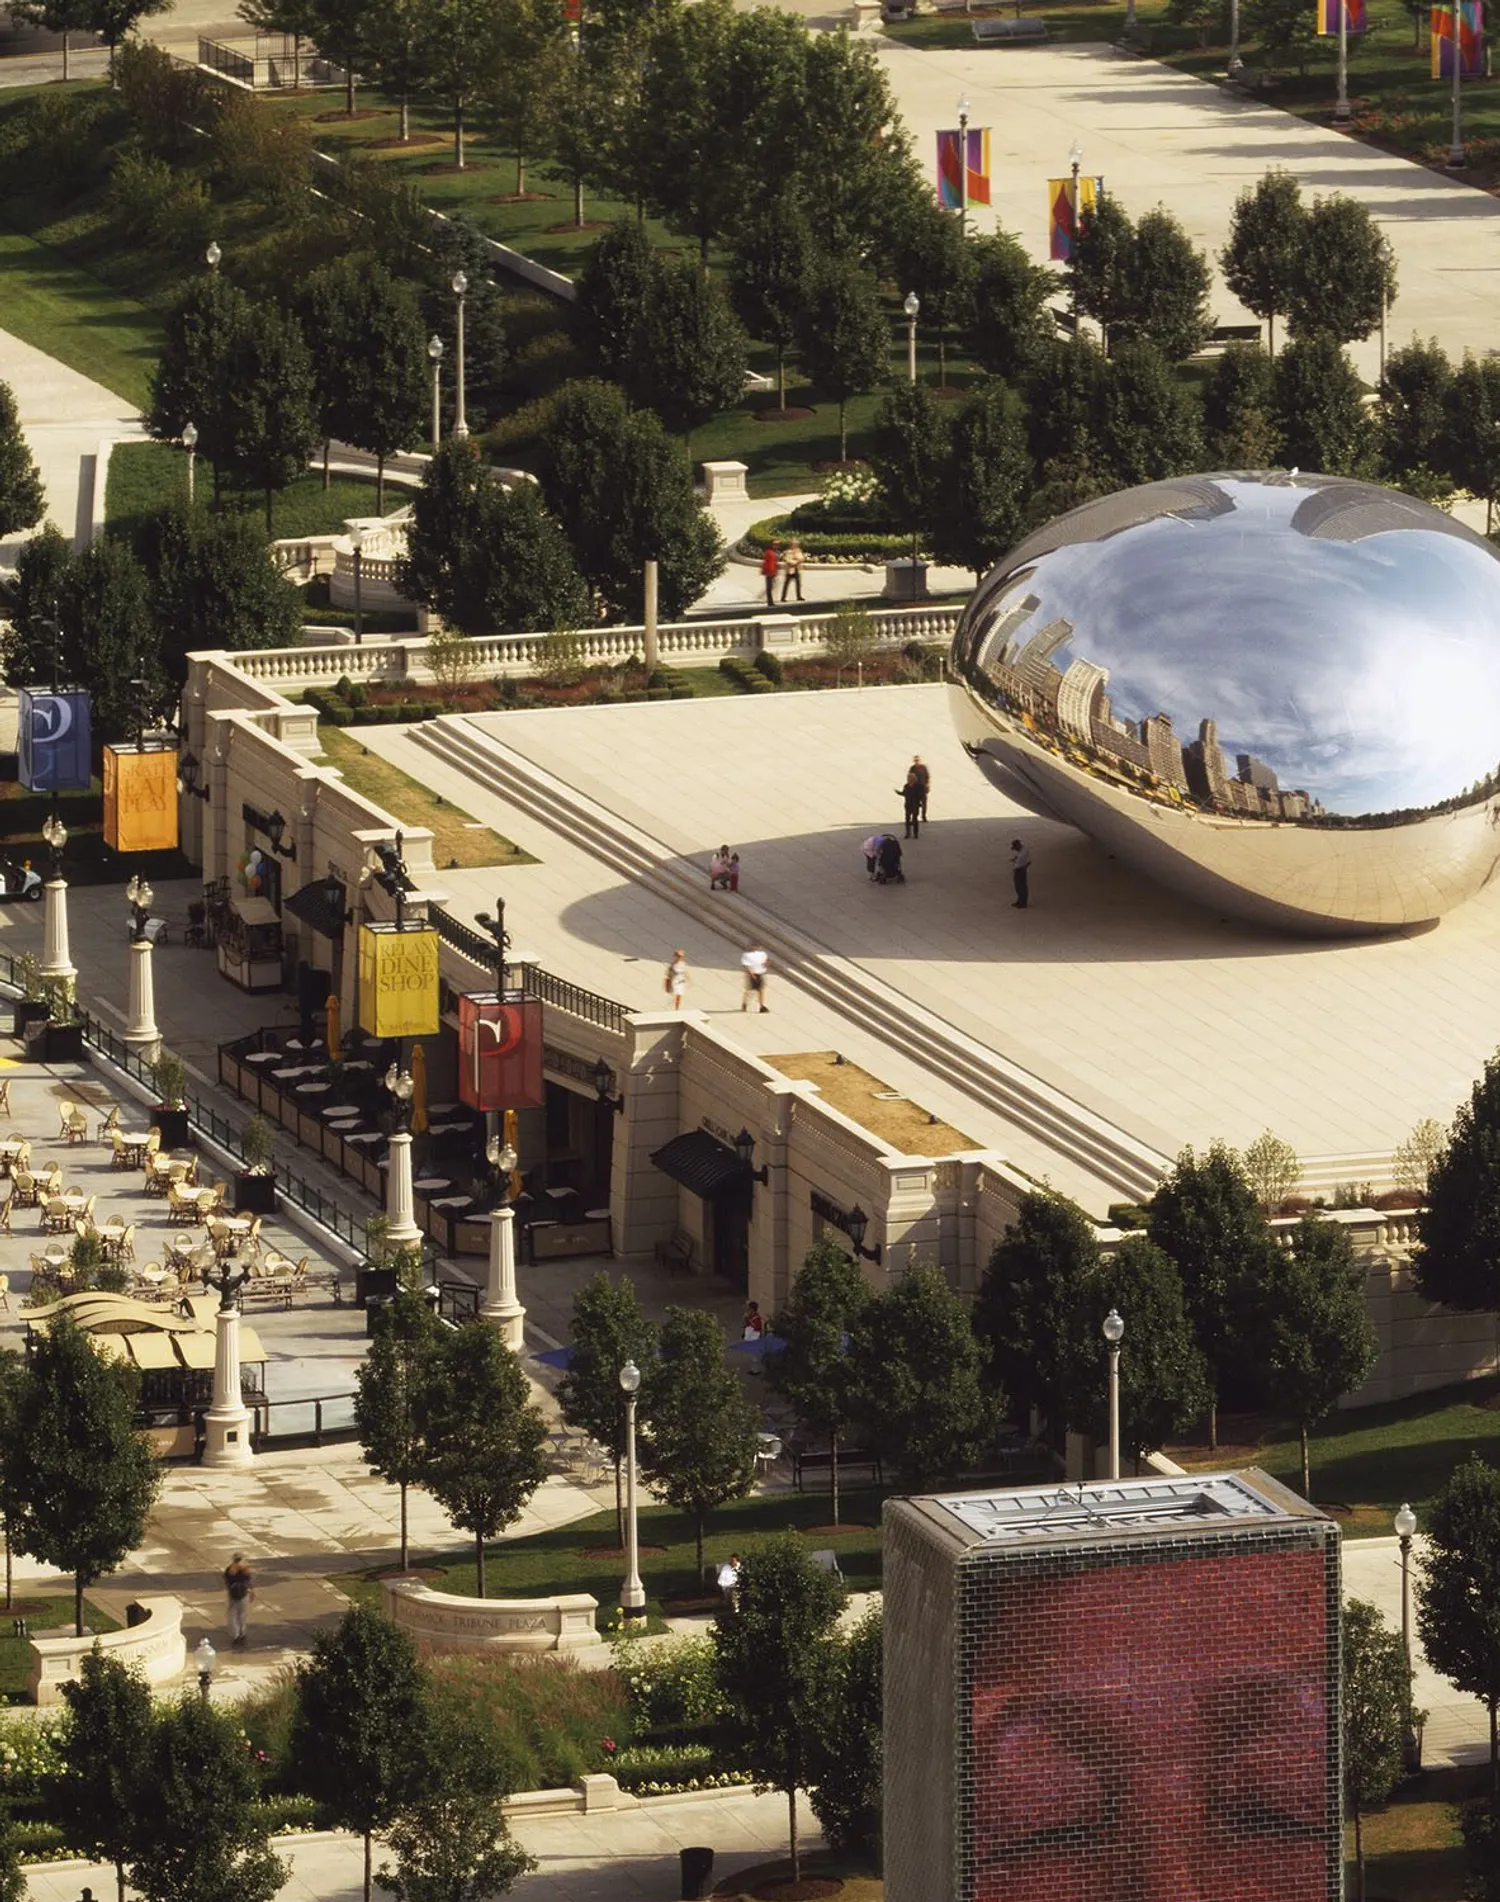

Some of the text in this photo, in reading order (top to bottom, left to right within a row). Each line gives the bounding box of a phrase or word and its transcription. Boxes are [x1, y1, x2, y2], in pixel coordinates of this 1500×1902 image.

[382, 955, 434, 975] DINE
[380, 973, 434, 992] SHOP
[452, 1614, 500, 1629] TRIBUNE
[508, 1614, 547, 1629] PLAZA
